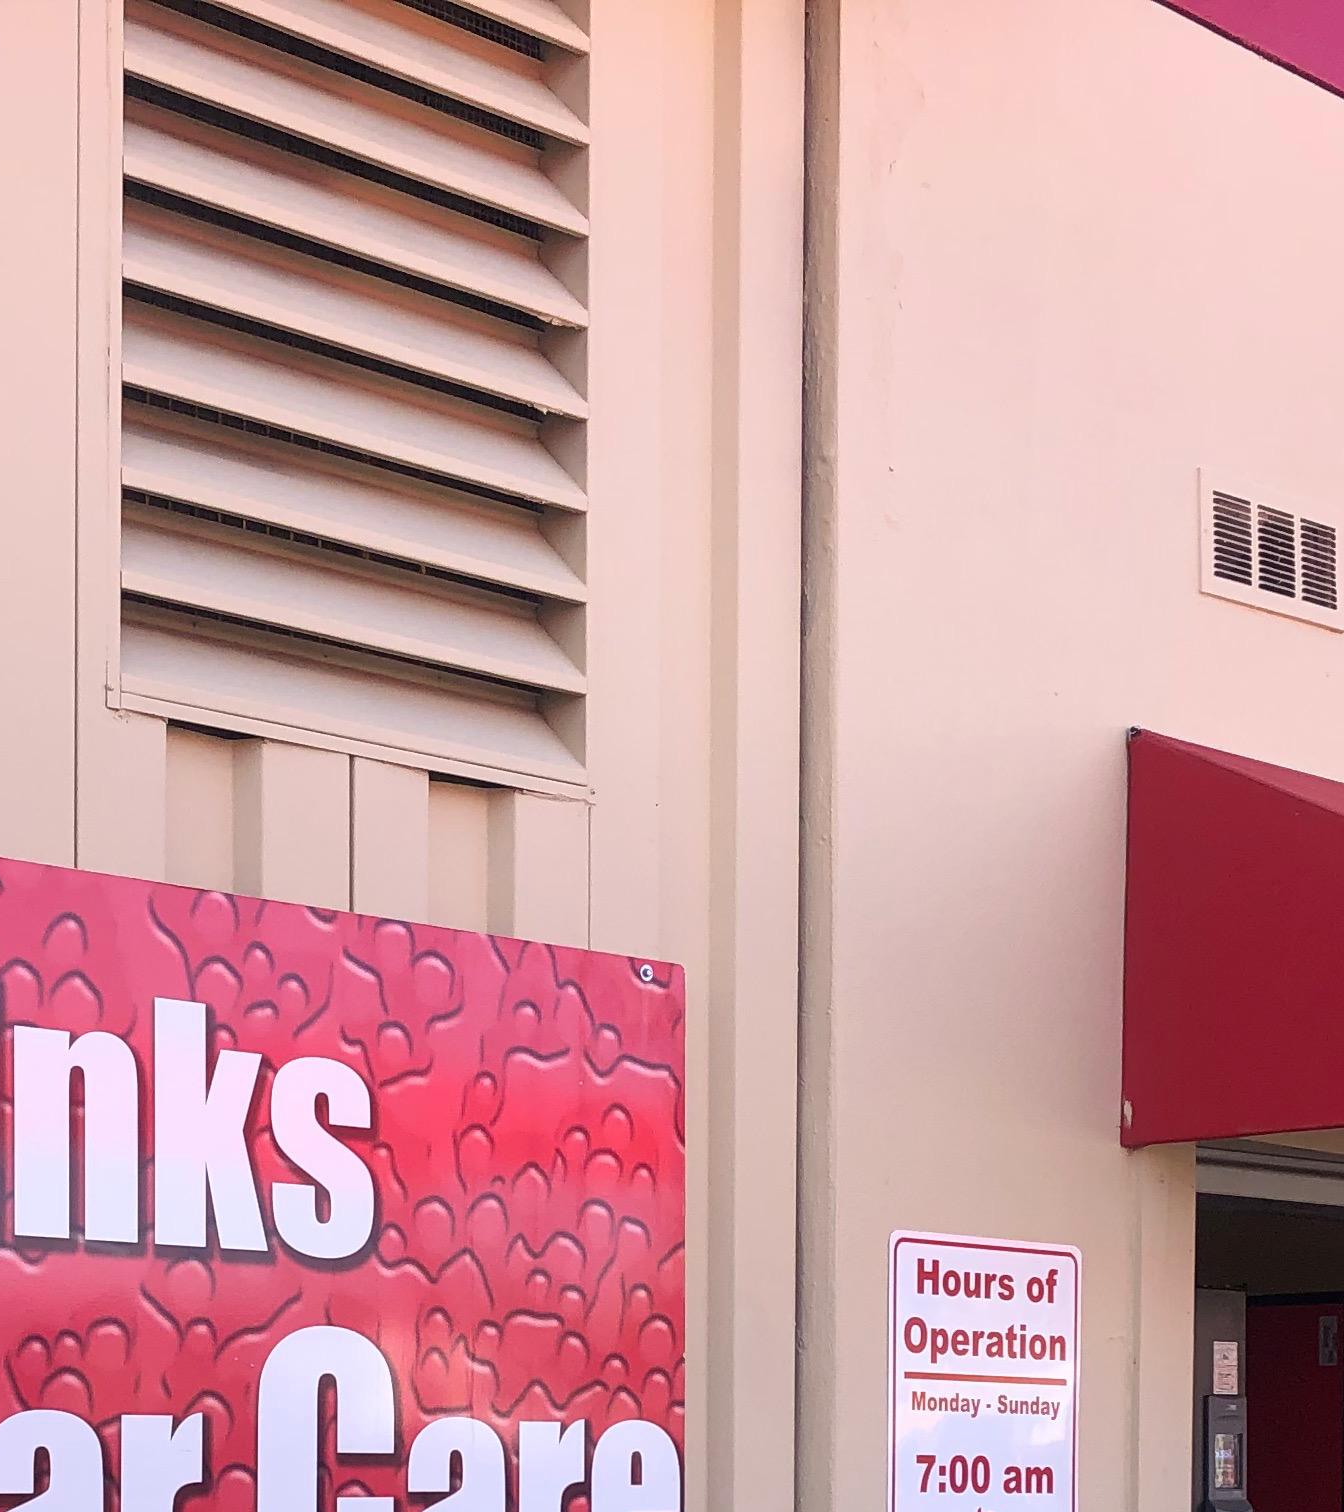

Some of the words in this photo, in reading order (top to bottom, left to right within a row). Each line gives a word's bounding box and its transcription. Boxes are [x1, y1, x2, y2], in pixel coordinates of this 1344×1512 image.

[916, 1258, 1015, 1301] Hours
[1026, 1268, 1059, 1305] of
[903, 1317, 1068, 1364] Operation
[911, 1391, 981, 1418] Monday
[997, 1395, 1061, 1420] Sunday
[915, 1454, 991, 1494] 7:00
[1002, 1465, 1055, 1494] am
